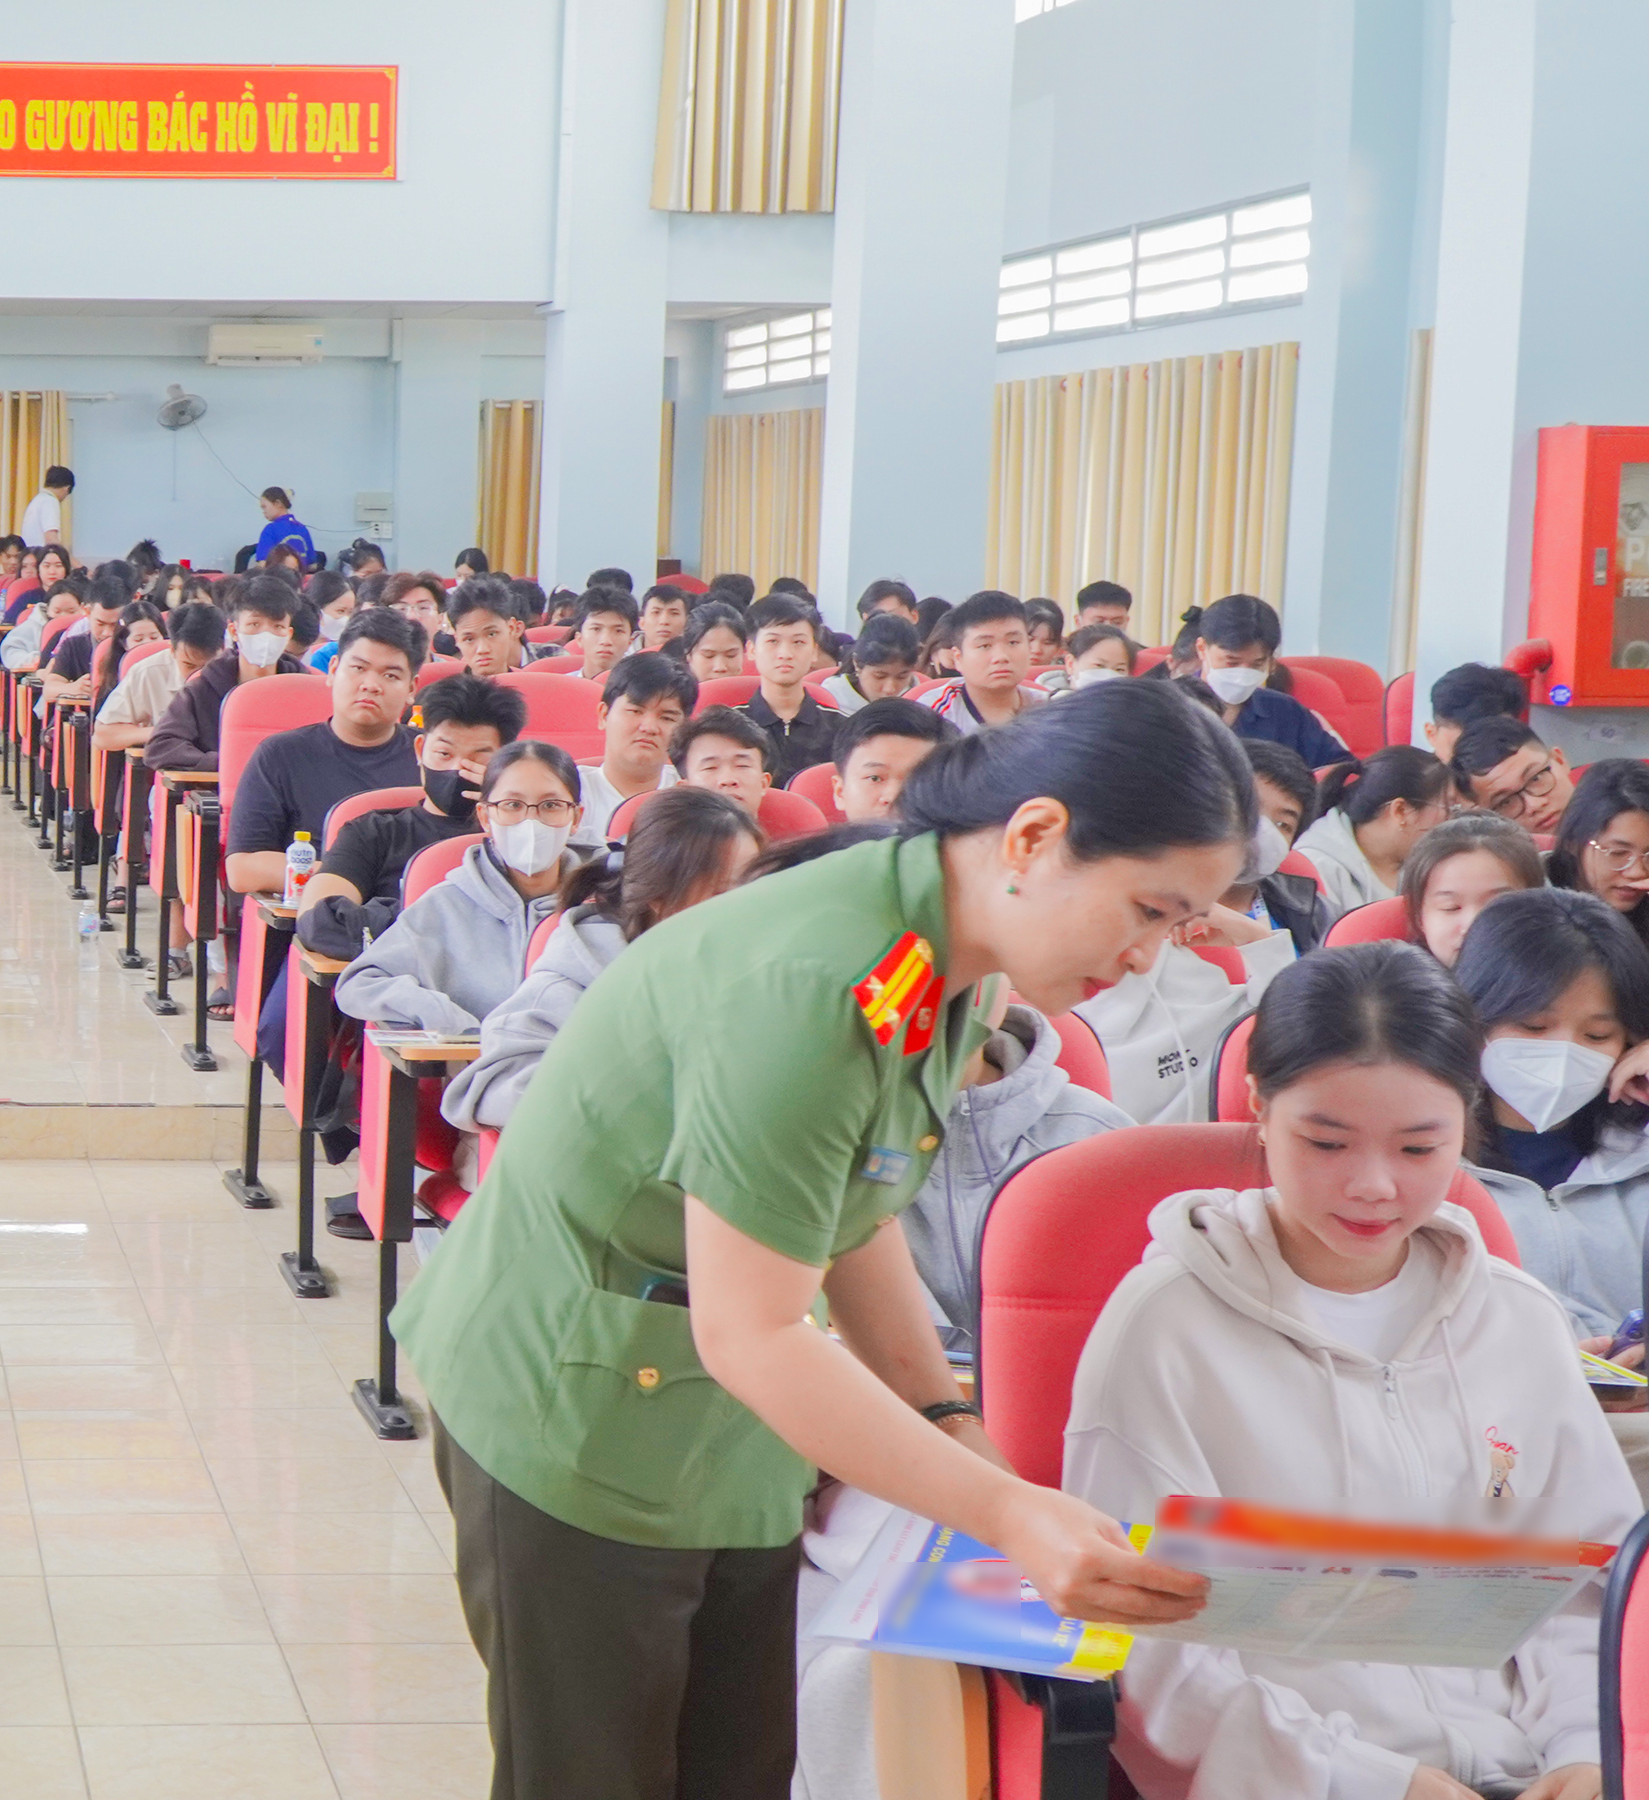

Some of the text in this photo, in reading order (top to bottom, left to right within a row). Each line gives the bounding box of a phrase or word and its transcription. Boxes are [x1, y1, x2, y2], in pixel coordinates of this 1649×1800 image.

[25, 99, 138, 152] GƯƠNG
[147, 91, 207, 152] BÁC
[216, 81, 258, 152] HỒ
[266, 92, 298, 152] VĨ
[305, 102, 360, 162] ĐẠI
[369, 102, 379, 153] !
